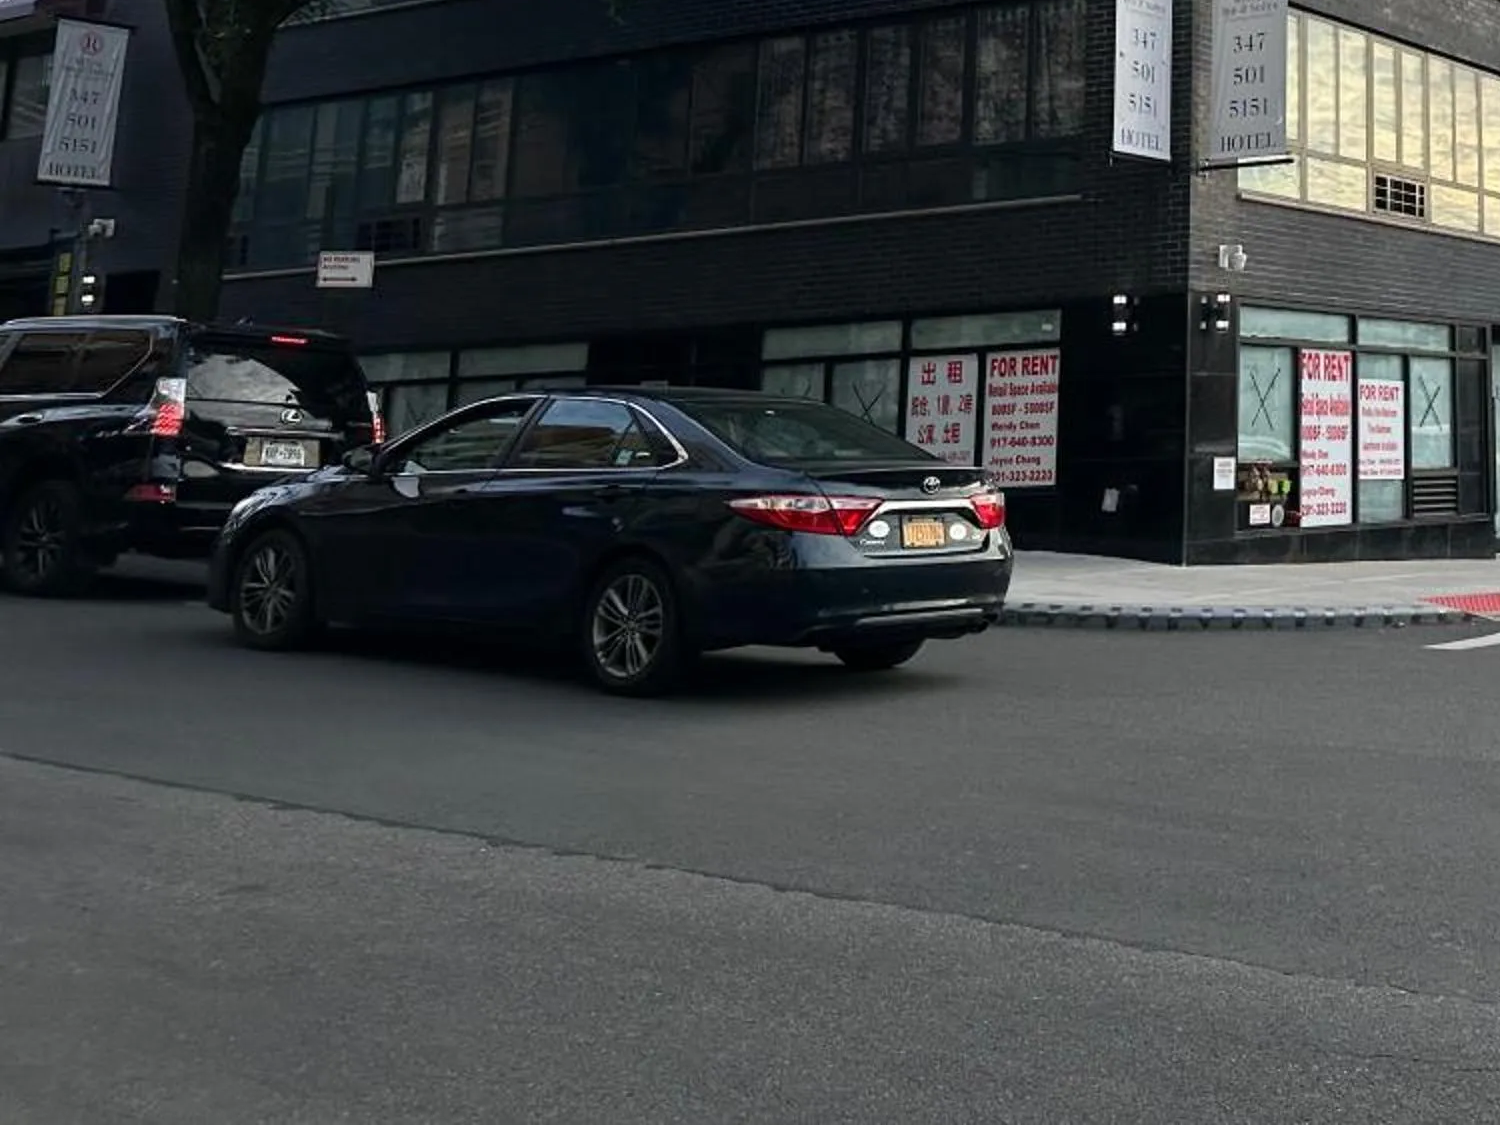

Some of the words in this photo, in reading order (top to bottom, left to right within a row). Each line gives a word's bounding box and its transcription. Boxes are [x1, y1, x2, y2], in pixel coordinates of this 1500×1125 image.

[1132, 28, 1157, 51] 347
[1232, 31, 1267, 54] 347
[1132, 60, 1156, 84] 501
[1232, 65, 1266, 86] 501
[69, 87, 101, 105] 347
[1127, 92, 1158, 119] 5151
[1229, 97, 1268, 119] 5151
[65, 112, 97, 130] 501
[58, 137, 97, 154] 5151
[1120, 126, 1164, 152] HOTEL
[1219, 131, 1277, 154] HOTEL
[48, 161, 97, 179] HOTEL
[991, 357, 1017, 378] FOR
[1022, 355, 1058, 376] RENT
[1300, 352, 1321, 380] FOR
[1323, 353, 1349, 382] RENT
[1360, 385, 1377, 401] FOR
[1378, 385, 1400, 402] RENT
